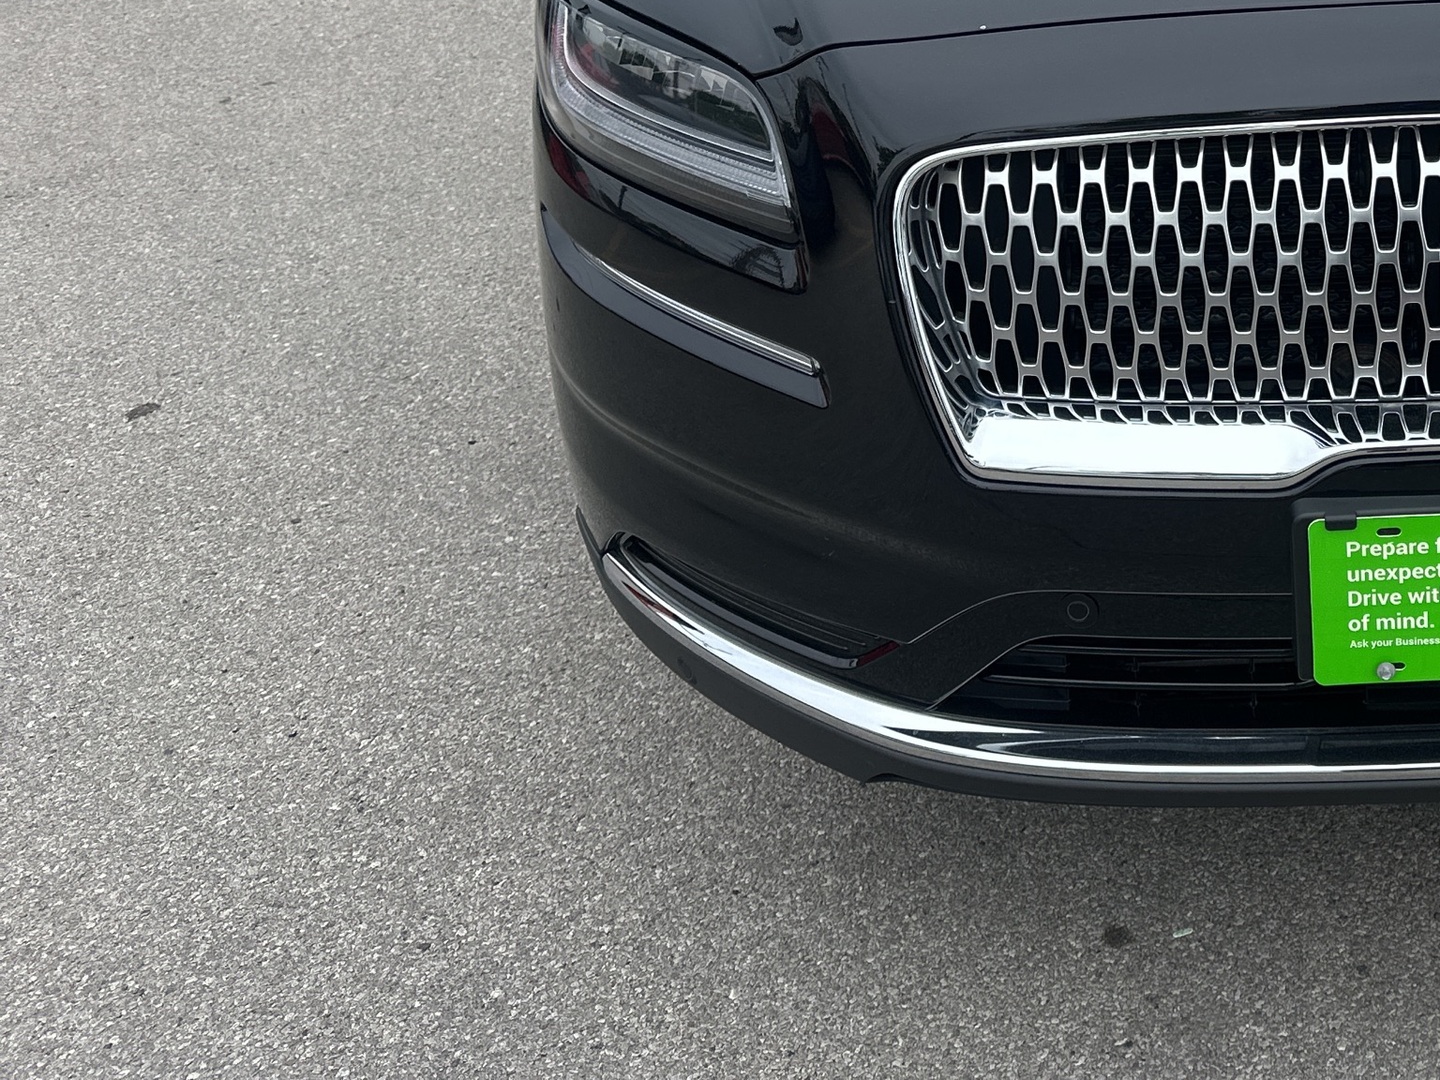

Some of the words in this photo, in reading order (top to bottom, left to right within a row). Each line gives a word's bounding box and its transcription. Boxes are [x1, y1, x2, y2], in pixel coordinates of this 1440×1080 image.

[1346, 540, 1430, 560] Prepare
[1347, 589, 1402, 607] Drive
[1347, 614, 1371, 632] of
[1375, 611, 1435, 631] mind.
[1349, 639, 1369, 648] Ask
[1370, 639, 1393, 650] your
[1395, 636, 1440, 647] Business
